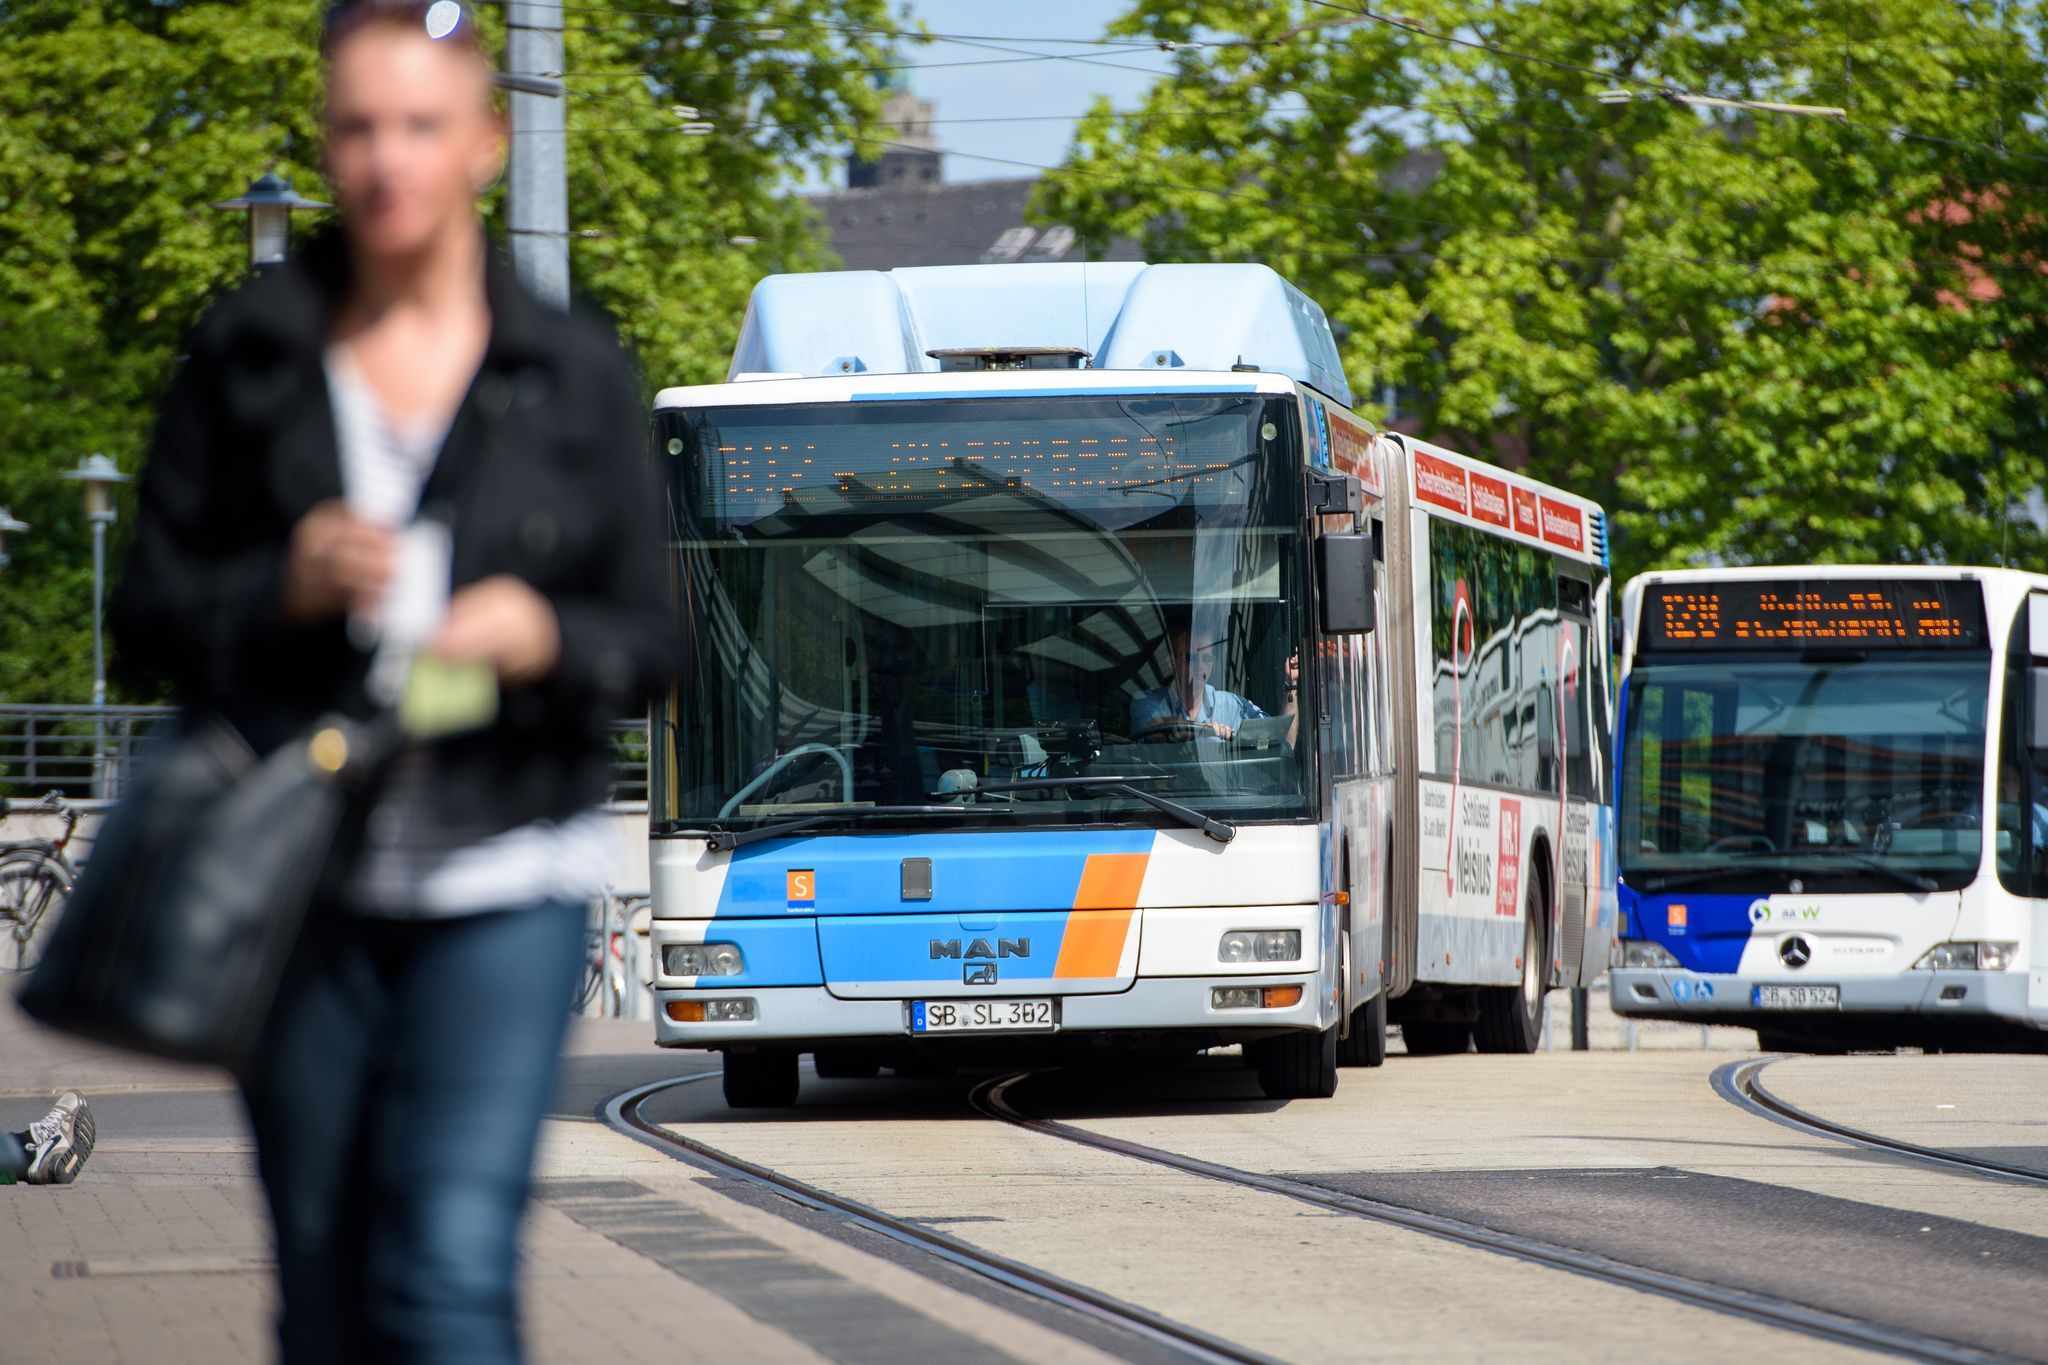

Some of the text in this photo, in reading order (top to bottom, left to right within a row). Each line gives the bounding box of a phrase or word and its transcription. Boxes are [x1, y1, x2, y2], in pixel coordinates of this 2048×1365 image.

[1456, 836, 1491, 896] Neisius
[794, 875, 807, 897] S
[929, 938, 1030, 959] MAN
[929, 1004, 957, 1027] SB
[974, 1003, 1002, 1025] SL
